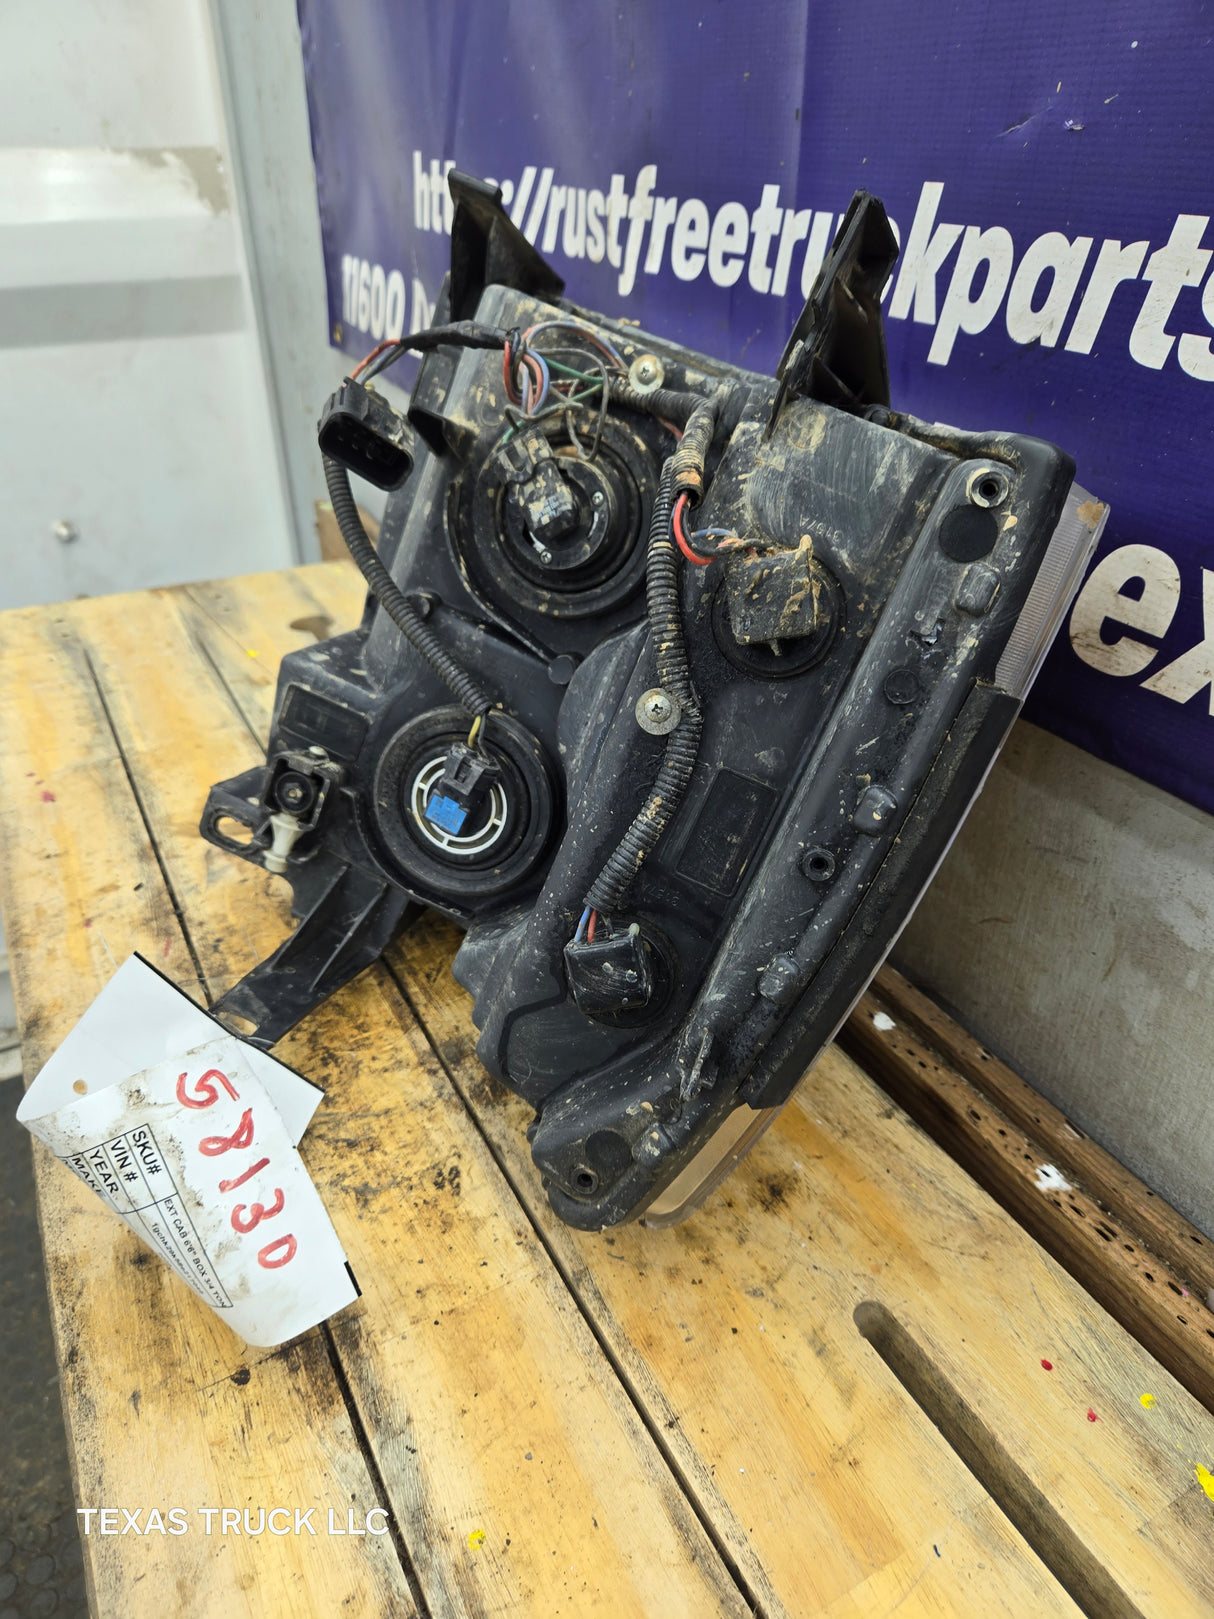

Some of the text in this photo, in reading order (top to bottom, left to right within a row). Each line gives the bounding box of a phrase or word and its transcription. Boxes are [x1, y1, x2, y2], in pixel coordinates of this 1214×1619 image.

[90, 1149, 119, 1194] YEAR
[111, 1139, 139, 1183] VIN #
[132, 1130, 162, 1176] SKU#
[164, 1198, 179, 1217] EXT
[173, 1218, 188, 1239] CAB
[193, 1257, 208, 1277] BOX
[213, 1291, 227, 1308] TON
